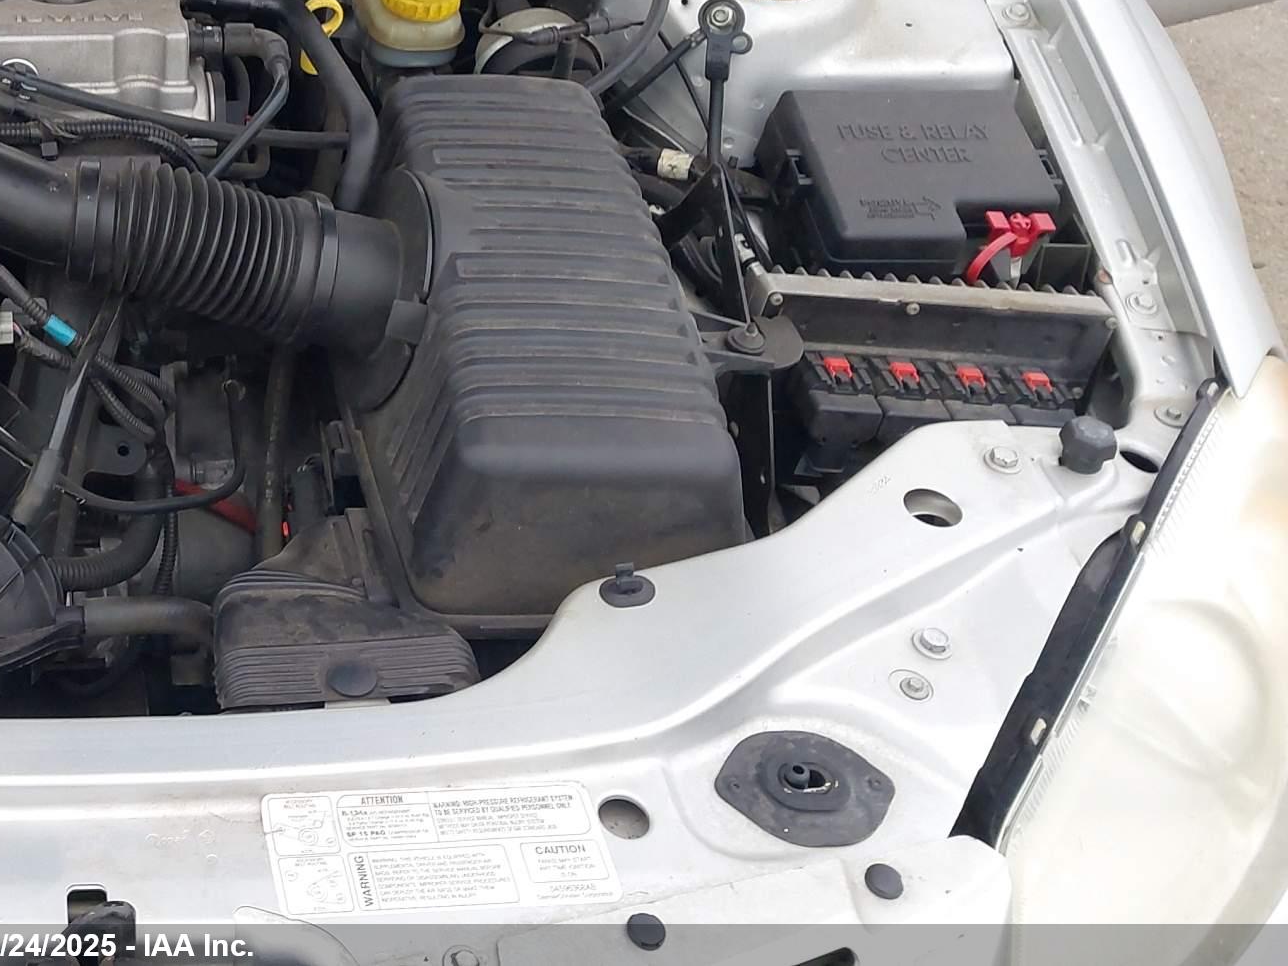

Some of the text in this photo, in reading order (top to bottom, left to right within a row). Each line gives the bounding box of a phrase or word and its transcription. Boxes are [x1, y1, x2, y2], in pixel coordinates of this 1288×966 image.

[836, 123, 894, 141] FUSE
[920, 123, 990, 141] RELAY
[880, 145, 973, 164] CENTER
[361, 795, 404, 805] ATTENTION
[535, 844, 587, 855] CAUTION
[354, 855, 374, 907] WARNING
